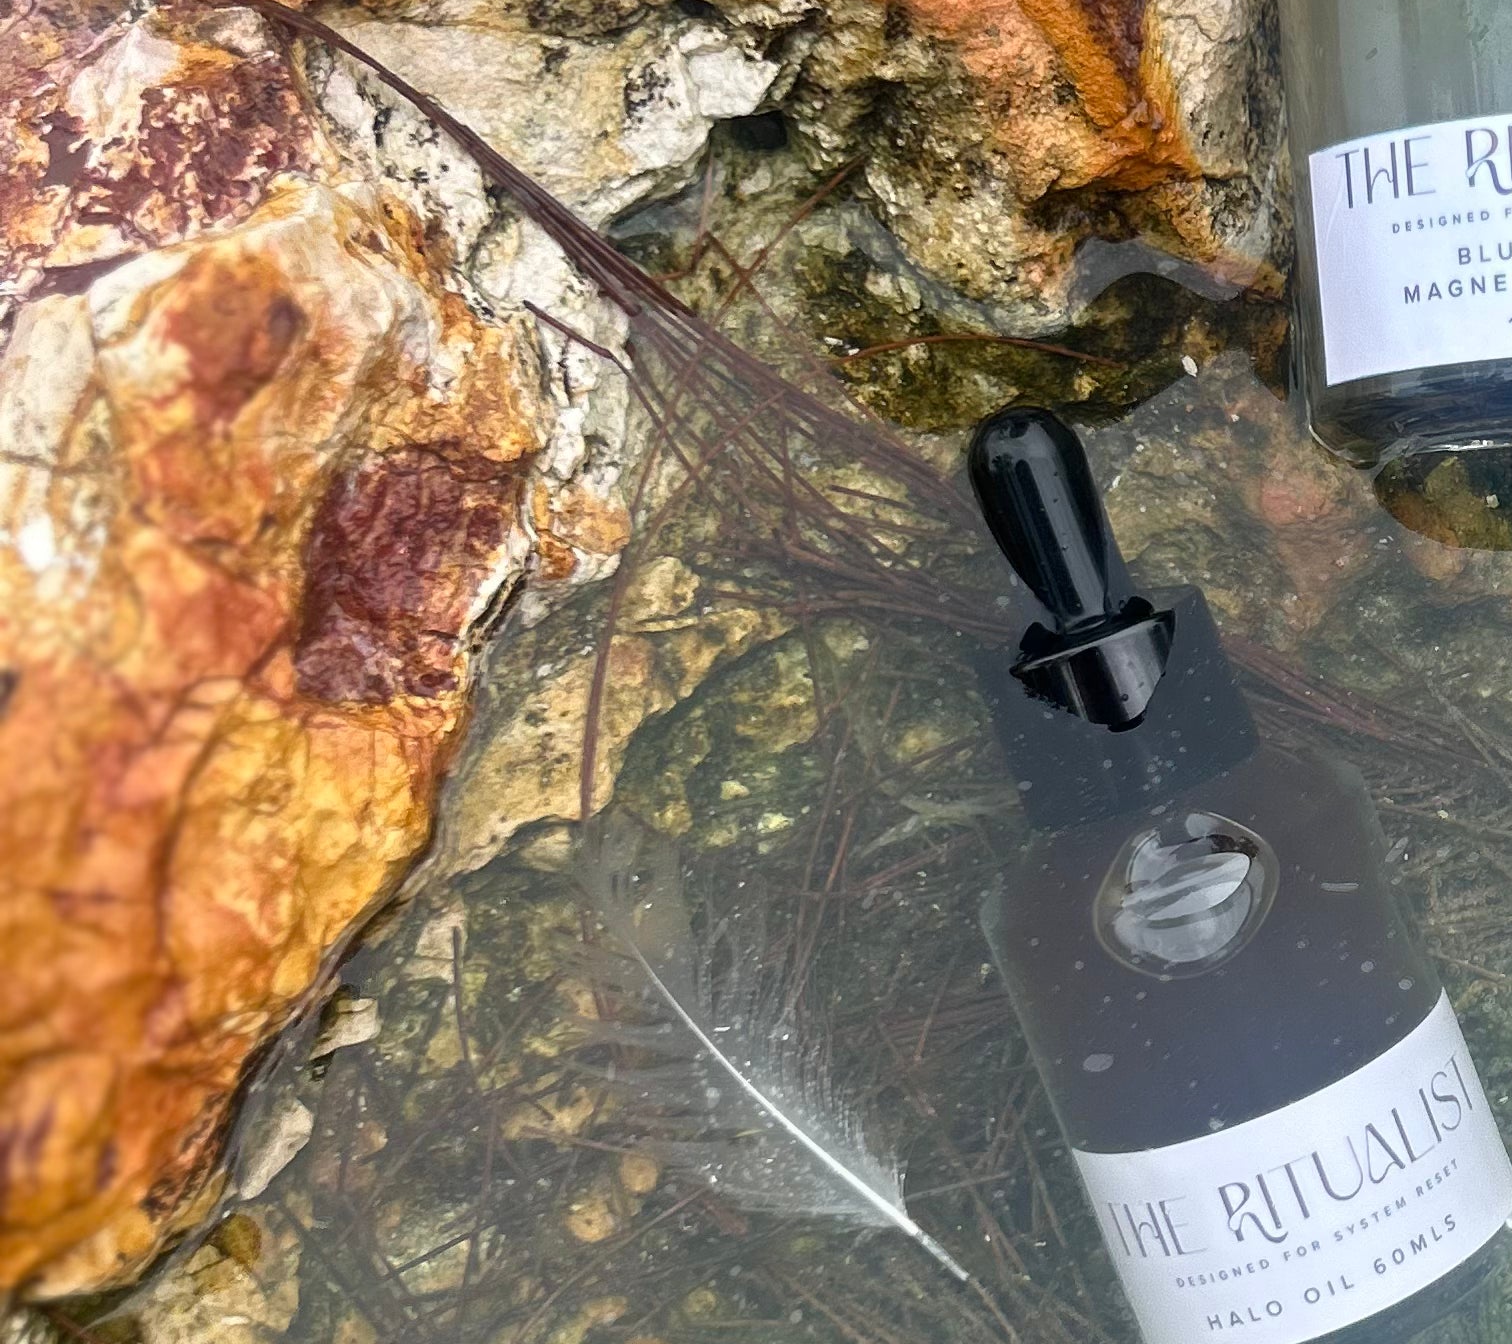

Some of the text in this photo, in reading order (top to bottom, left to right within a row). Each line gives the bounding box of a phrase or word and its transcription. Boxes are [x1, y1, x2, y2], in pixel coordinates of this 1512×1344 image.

[1335, 135, 1437, 209] THE
[1391, 210, 1491, 234] DESIGNED
[1106, 1054, 1473, 1258] THE RITUALIST
[1175, 1158, 1459, 1289] DESIGNED FOR SYSTEM RESET
[1207, 1213, 1458, 1331] HALO OIL 60MLS
